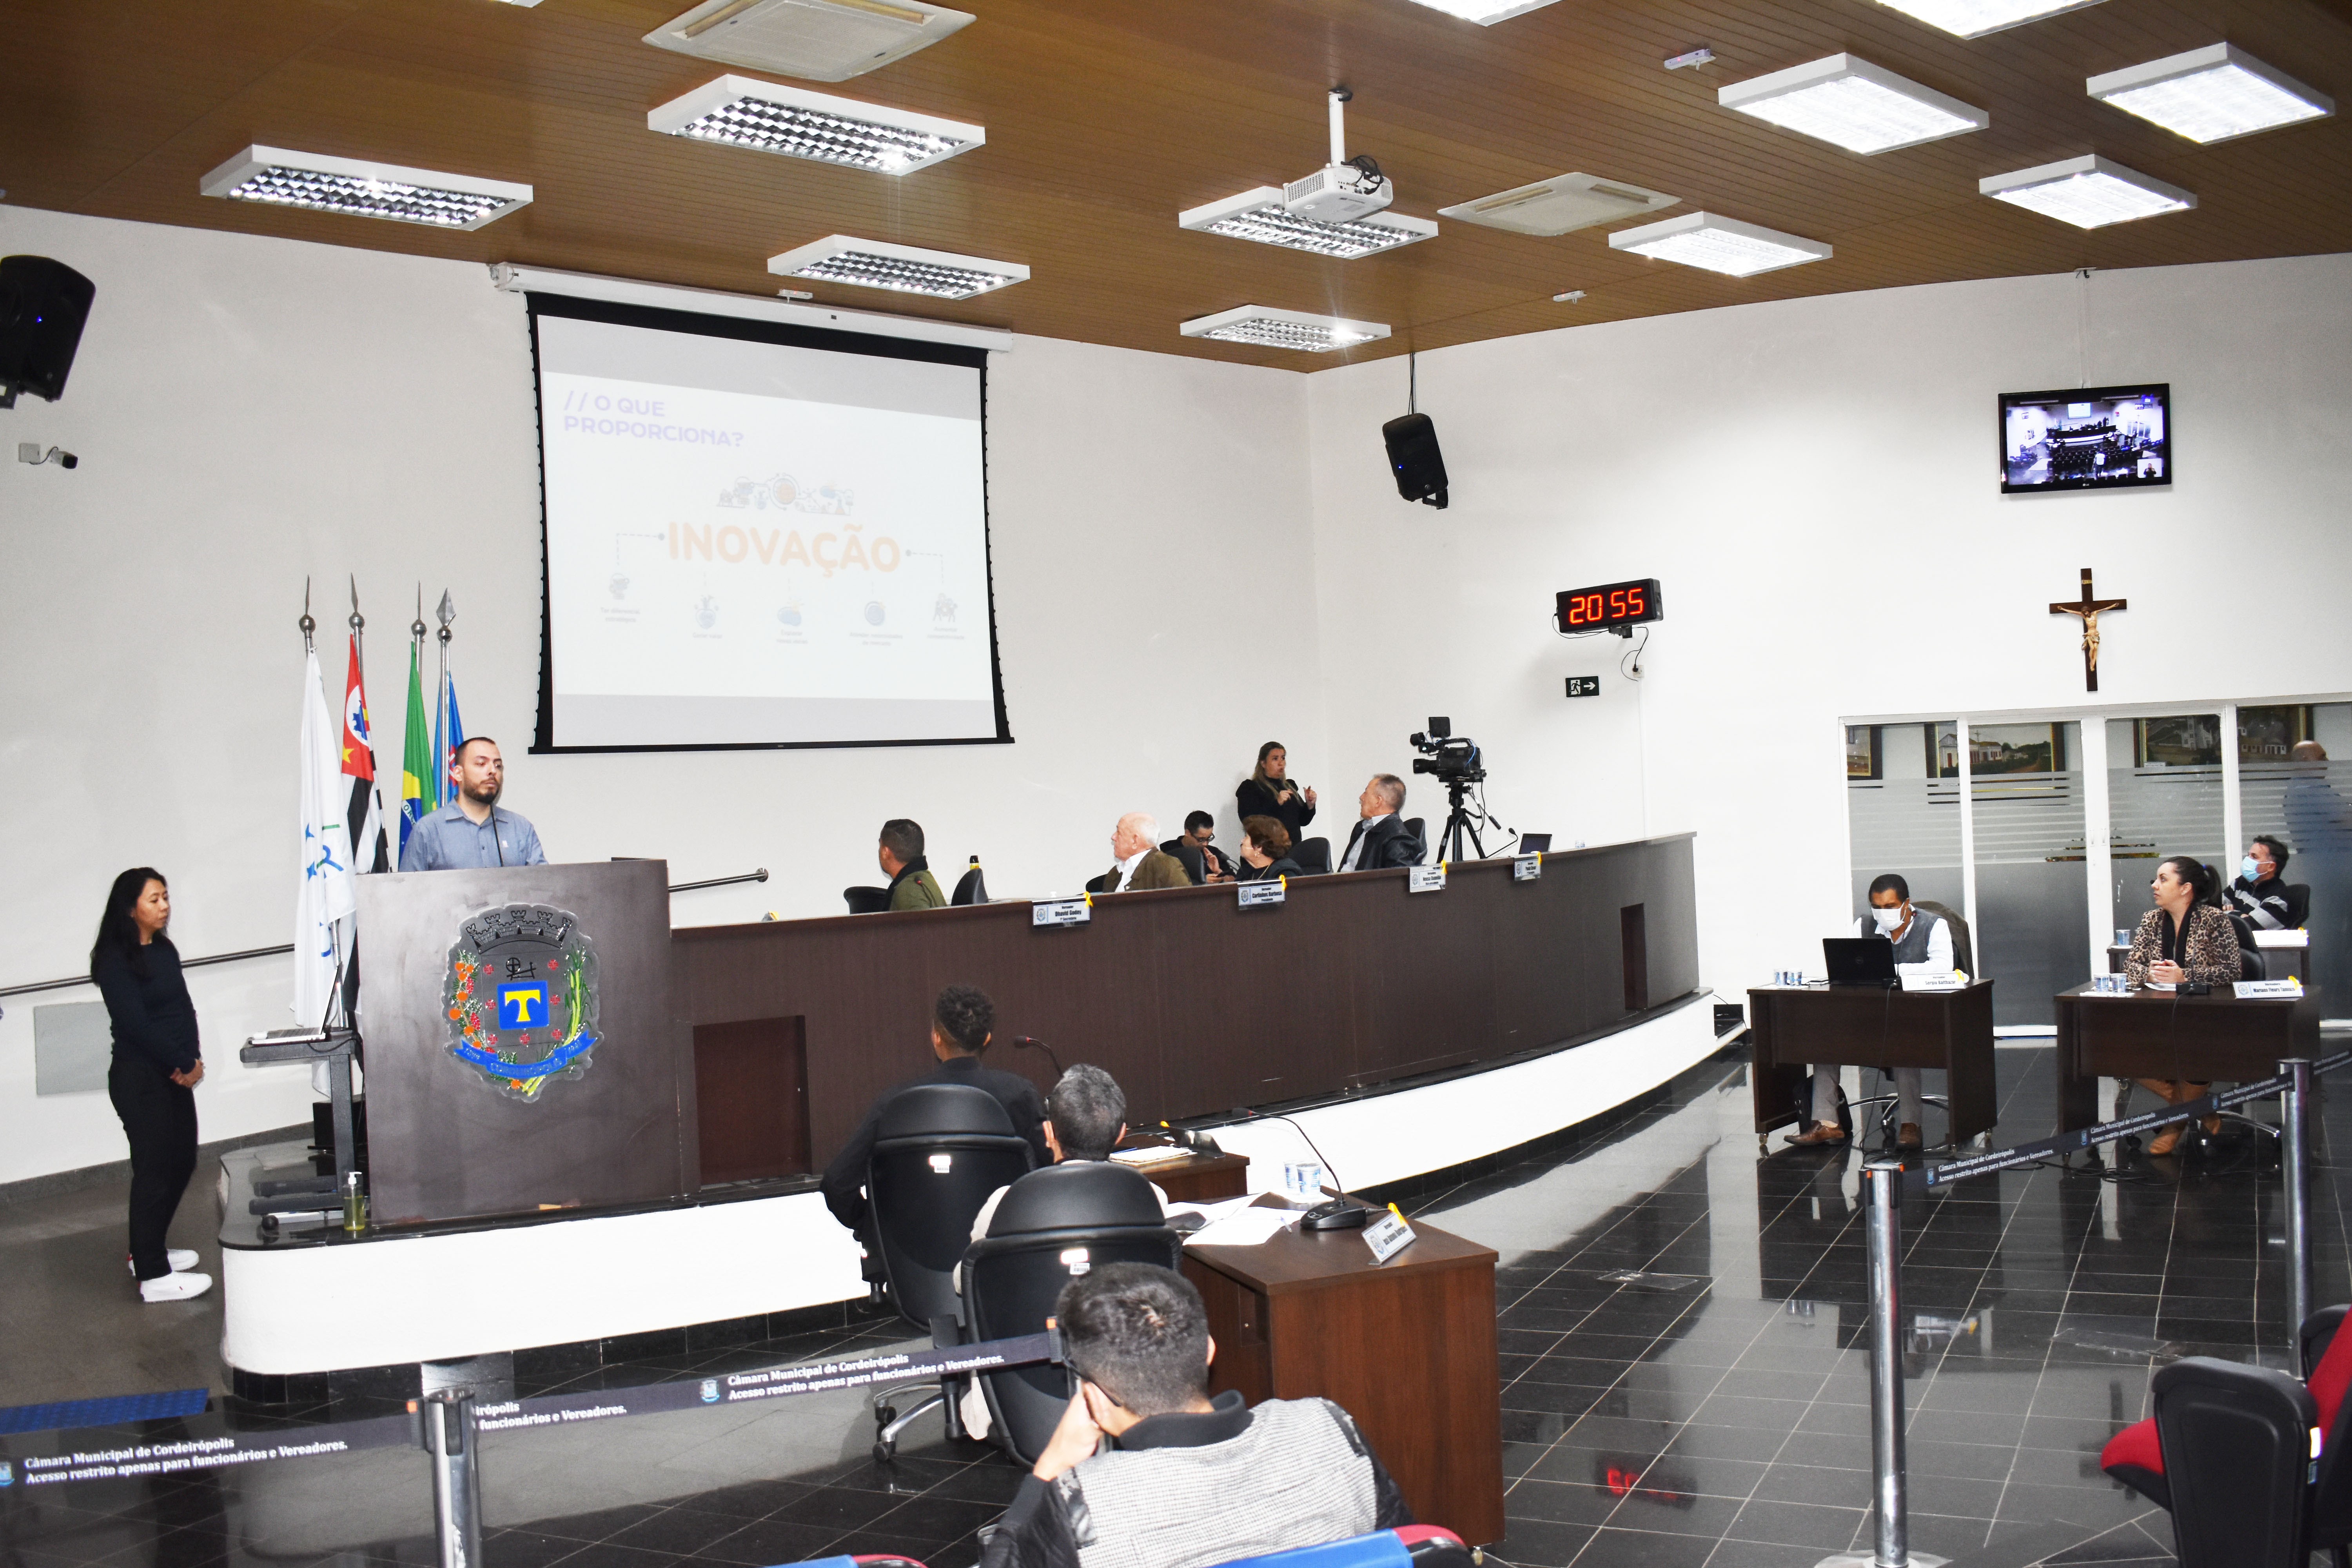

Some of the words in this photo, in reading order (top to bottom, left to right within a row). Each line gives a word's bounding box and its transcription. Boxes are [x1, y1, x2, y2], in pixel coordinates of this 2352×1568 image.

[594, 395, 611, 411] O
[617, 398, 665, 417] QUE
[564, 415, 744, 447] PROPORCIONA?
[668, 522, 900, 577] INOVAÇÃO
[1570, 594, 1603, 624] 20
[1611, 588, 1643, 617] 55
[1938, 1162, 1956, 1172] Câmara
[1956, 1156, 1978, 1168] Municipal
[1985, 1148, 2014, 1161] Cordeirópolis
[1938, 1174, 1954, 1183] Acesso
[1955, 1169, 1972, 1178] restrito
[1972, 1165, 1988, 1175] apenas
[1988, 1162, 1999, 1171] para
[1999, 1156, 2026, 1167] funcionários
[2029, 1149, 2054, 1159] Vereadores.
[728, 1373, 769, 1386] Câmara
[770, 1365, 823, 1380] Municipal
[824, 1363, 837, 1374] de
[839, 1354, 909, 1372] Cordeirópolis
[729, 1388, 765, 1400] Acesso
[766, 1382, 807, 1395] restrito
[808, 1377, 846, 1391] apenas
[847, 1374, 871, 1387] para
[872, 1364, 936, 1381] funcionários
[945, 1355, 1004, 1370] Vereadores.
[479, 1414, 550, 1430] funcionários
[552, 1412, 560, 1422] e
[561, 1405, 627, 1420] Vereadores.
[24, 1455, 71, 1469] Câmara
[73, 1447, 134, 1463] Municipal
[135, 1446, 151, 1458] de
[152, 1437, 234, 1456] Cordeirópolis
[25, 1472, 67, 1484] Acesso
[68, 1466, 115, 1480] restrito
[117, 1461, 160, 1477] apenas
[161, 1457, 191, 1472] para
[192, 1450, 267, 1467] funcionários
[268, 1449, 277, 1458] e
[278, 1441, 348, 1457] Vereadores.
